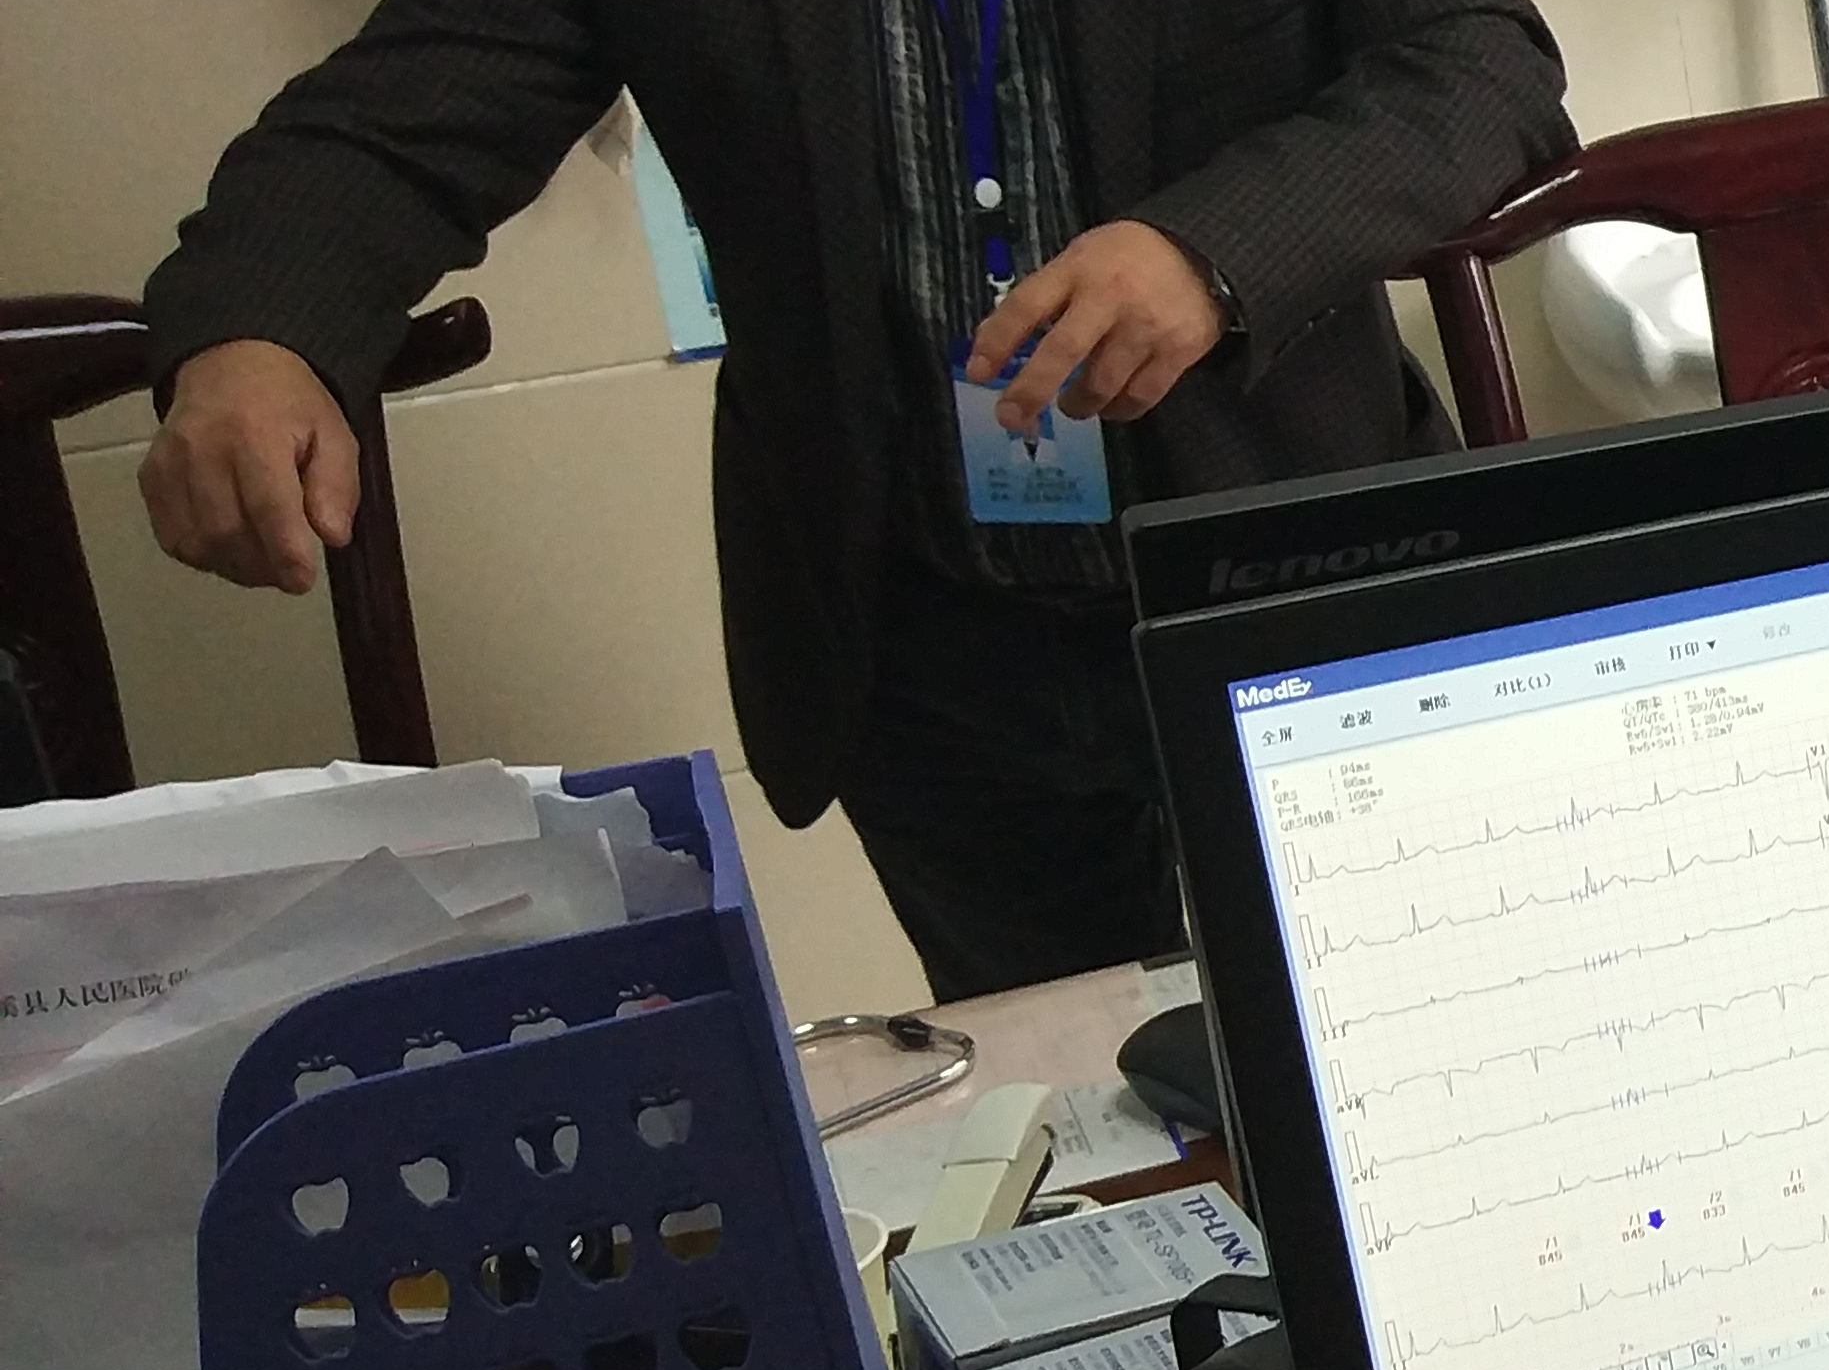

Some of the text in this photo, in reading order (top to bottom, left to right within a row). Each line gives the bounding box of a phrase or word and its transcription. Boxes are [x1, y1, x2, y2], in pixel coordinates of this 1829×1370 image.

[1209, 530, 1460, 596] lenovo
[1668, 641, 1702, 662] 打印
[1418, 693, 1452, 714] 删除
[1261, 726, 1295, 747] 全屏
[1181, 1193, 1258, 1270] TP-LINK
